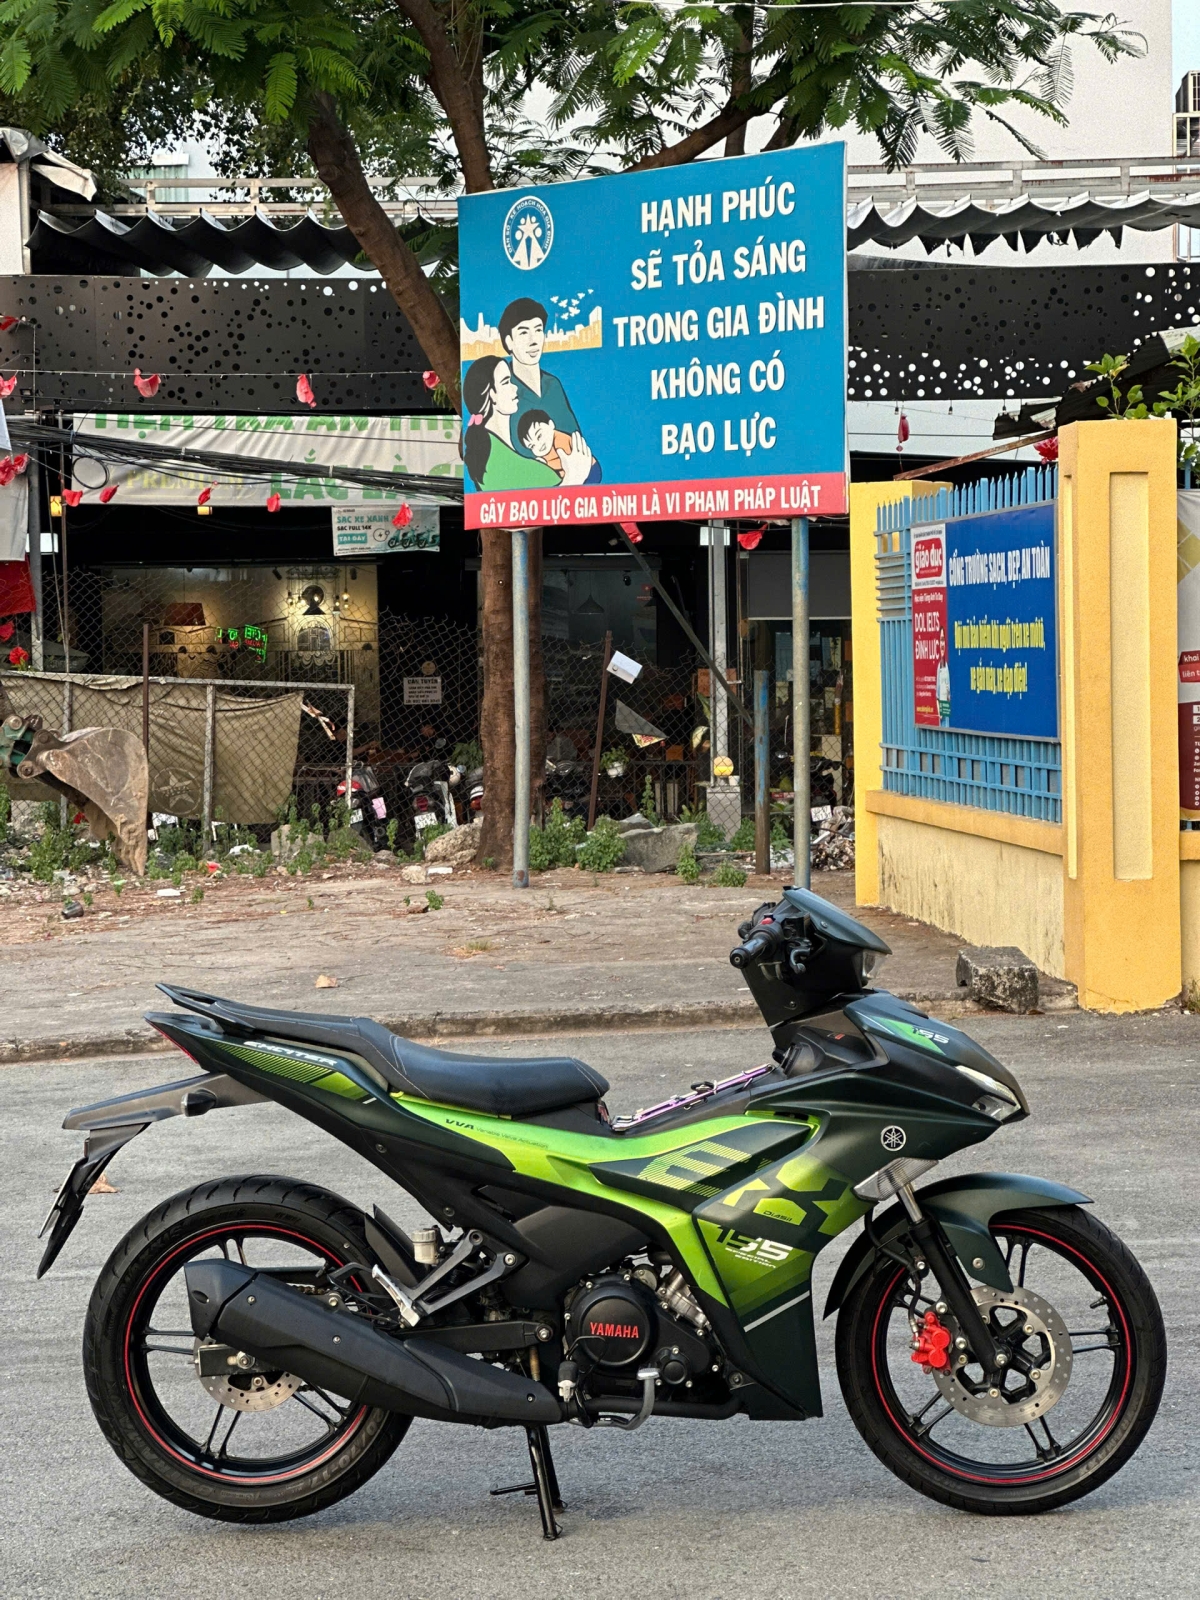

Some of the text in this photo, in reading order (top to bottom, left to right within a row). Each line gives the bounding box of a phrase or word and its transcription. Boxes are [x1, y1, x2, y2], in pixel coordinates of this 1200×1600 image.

[641, 176, 795, 238] HẠNH PHÚC
[631, 236, 806, 291] SẼ TỎA SÁNG
[613, 292, 824, 348] TRONG GIA ĐÌNH
[651, 350, 785, 401] KHÔNG CÓ
[662, 412, 777, 460] BẠO LỰC
[480, 483, 821, 525] GÂY BẠO LỰC GIA ĐÌNH LÀ VI PHẠM PHÁP LUẬT
[1022, 548, 1030, 579] AN
[1032, 540, 1050, 578] TOÀN
[926, 611, 940, 631] IELTS
[1182, 670, 1195, 678] liên
[1184, 654, 1199, 663] khai
[912, 1026, 949, 1044] 155
[446, 1118, 474, 1130] VVA
[716, 1224, 794, 1261] 155
[590, 1322, 639, 1338] YAMAHA
